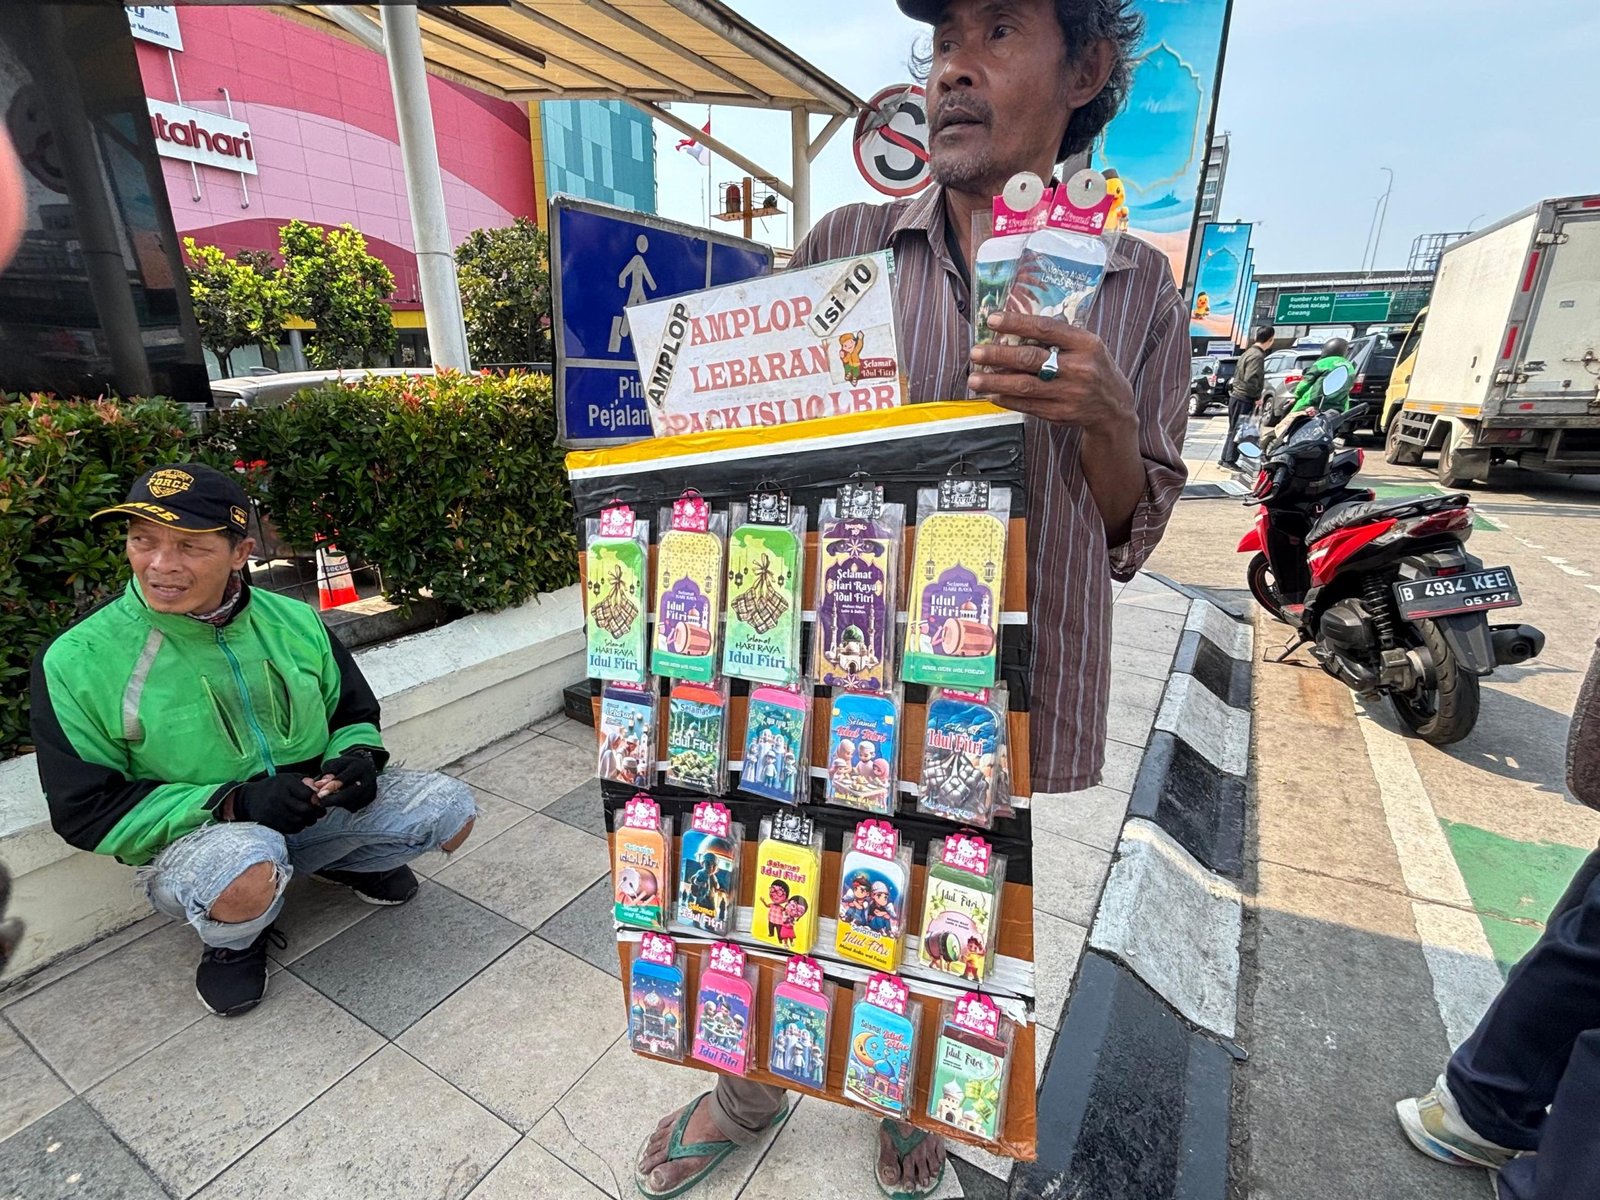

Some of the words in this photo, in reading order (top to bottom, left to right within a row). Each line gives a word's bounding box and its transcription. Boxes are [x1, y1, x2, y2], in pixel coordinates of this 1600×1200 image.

[138, 24, 169, 38] Moments
[815, 296, 846, 331] Isi
[844, 263, 872, 296] 10
[690, 295, 812, 347] AMPLOP
[648, 302, 690, 406] AMPLOP
[689, 339, 831, 393] LEBARAN
[863, 359, 892, 369] Selamat
[828, 384, 895, 414] LBR
[588, 404, 650, 431] Pejalan
[146, 477, 191, 491] FORCE
[837, 569, 872, 579] Selamat
[832, 579, 852, 591] Hari
[854, 581, 877, 593] Raya
[1402, 587, 1414, 601] B
[1425, 579, 1466, 597] 4934
[1472, 573, 1508, 589] KEE
[834, 592, 852, 602] Idul
[854, 593, 874, 603] Fitri
[931, 594, 955, 606] Idul
[666, 601, 684, 611] Idul
[931, 606, 960, 617] Fitri
[666, 611, 687, 621] Fitri
[746, 633, 771, 644] Selamat
[595, 646, 613, 656] HARI
[615, 647, 634, 657] RAYA
[735, 642, 756, 651] HARI
[757, 644, 780, 653] RAYA
[589, 655, 612, 668] Idul
[614, 656, 638, 671] Fitri
[729, 651, 754, 665] Idul
[757, 653, 786, 669] Fitri
[681, 703, 710, 715] Selamat
[848, 715, 877, 728] Selamat
[670, 737, 690, 749] Idul
[693, 739, 713, 752] Fitri
[928, 728, 953, 750] Idul
[954, 733, 983, 756] Fitri
[766, 859, 800, 871] Selamat
[761, 866, 782, 878] Idul
[783, 870, 806, 883] Fitri
[941, 889, 956, 902] Idul
[682, 908, 701, 921] Idul
[703, 915, 723, 930] Fitri
[852, 924, 881, 938] Selamat
[843, 931, 866, 946] Idul
[868, 940, 888, 956] Fitri
[699, 1044, 718, 1060] Idul
[720, 1052, 738, 1067] Fitri
[945, 1046, 961, 1061] Idul
[965, 1052, 984, 1070] Fitri
